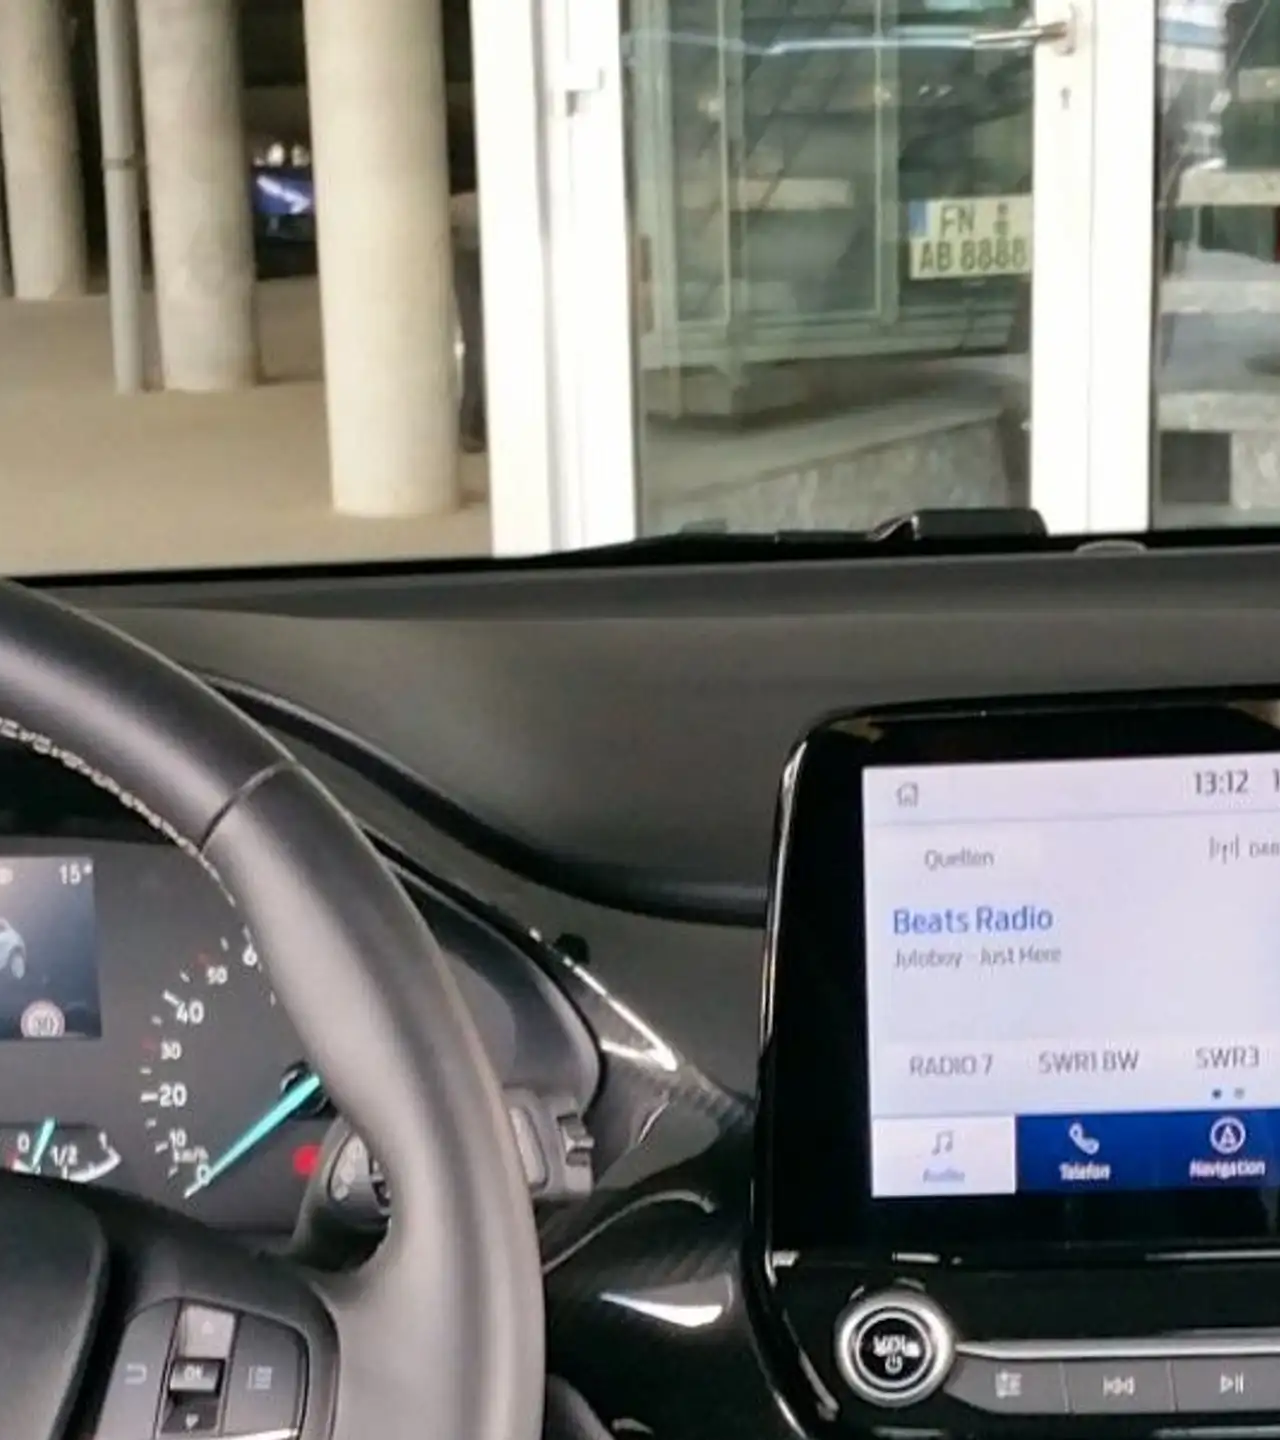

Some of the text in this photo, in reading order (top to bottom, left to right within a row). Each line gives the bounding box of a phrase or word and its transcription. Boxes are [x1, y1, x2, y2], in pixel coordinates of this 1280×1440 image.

[940, 204, 975, 236] FN
[921, 240, 952, 272] AB
[1194, 770, 1250, 795] 13:12
[924, 846, 995, 871] Quellen
[893, 904, 1054, 935] Beats Radio
[206, 966, 228, 985] 50
[176, 1000, 205, 1024] 40
[160, 1040, 183, 1060] 30
[1038, 1048, 1140, 1074] SWR1 BW
[1195, 1046, 1260, 1070] SWR3
[909, 1053, 995, 1076] RADIO 7
[159, 1083, 188, 1107] 20
[169, 1129, 187, 1149] 10
[1059, 1161, 1112, 1181] Telefon
[1188, 1157, 1266, 1180] Navigation
